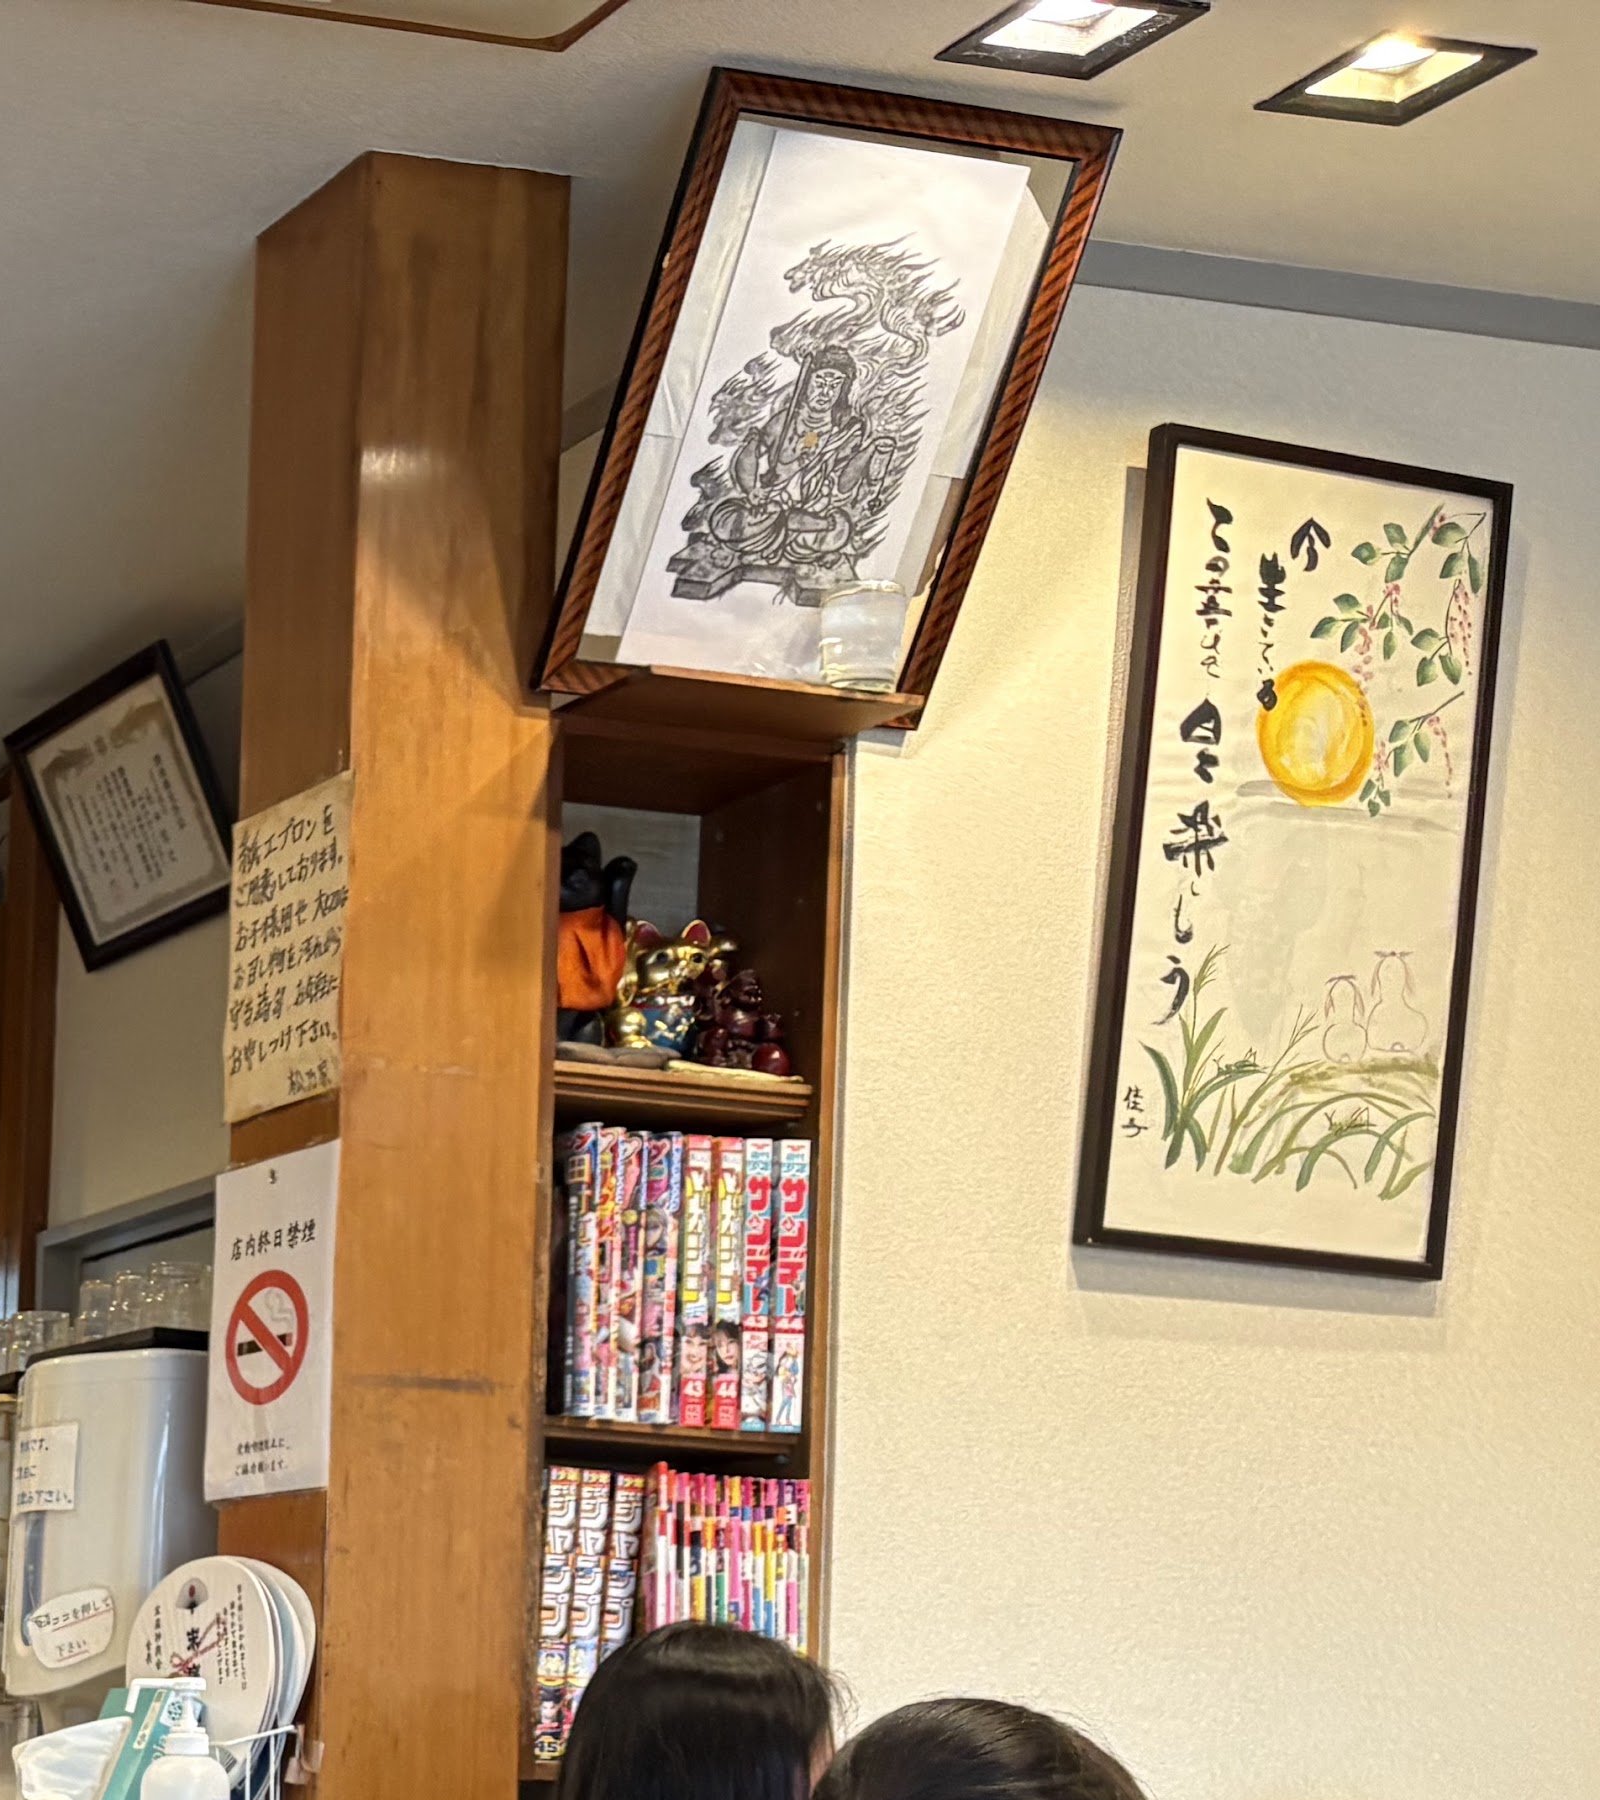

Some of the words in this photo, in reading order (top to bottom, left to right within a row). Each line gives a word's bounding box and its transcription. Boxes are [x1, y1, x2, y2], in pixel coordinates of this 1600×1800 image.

[230, 1218, 316, 1261] 店内終日禁煙
[778, 1177, 808, 1316] サンデー
[744, 1316, 767, 1328] 43
[776, 1317, 803, 1330] 44
[684, 1381, 704, 1398] 43
[717, 1381, 737, 1398] 44
[540, 1483, 577, 1642] ジャンプ
[569, 1484, 610, 1641] ジャンプ
[604, 1490, 644, 1642] ジャンプ
